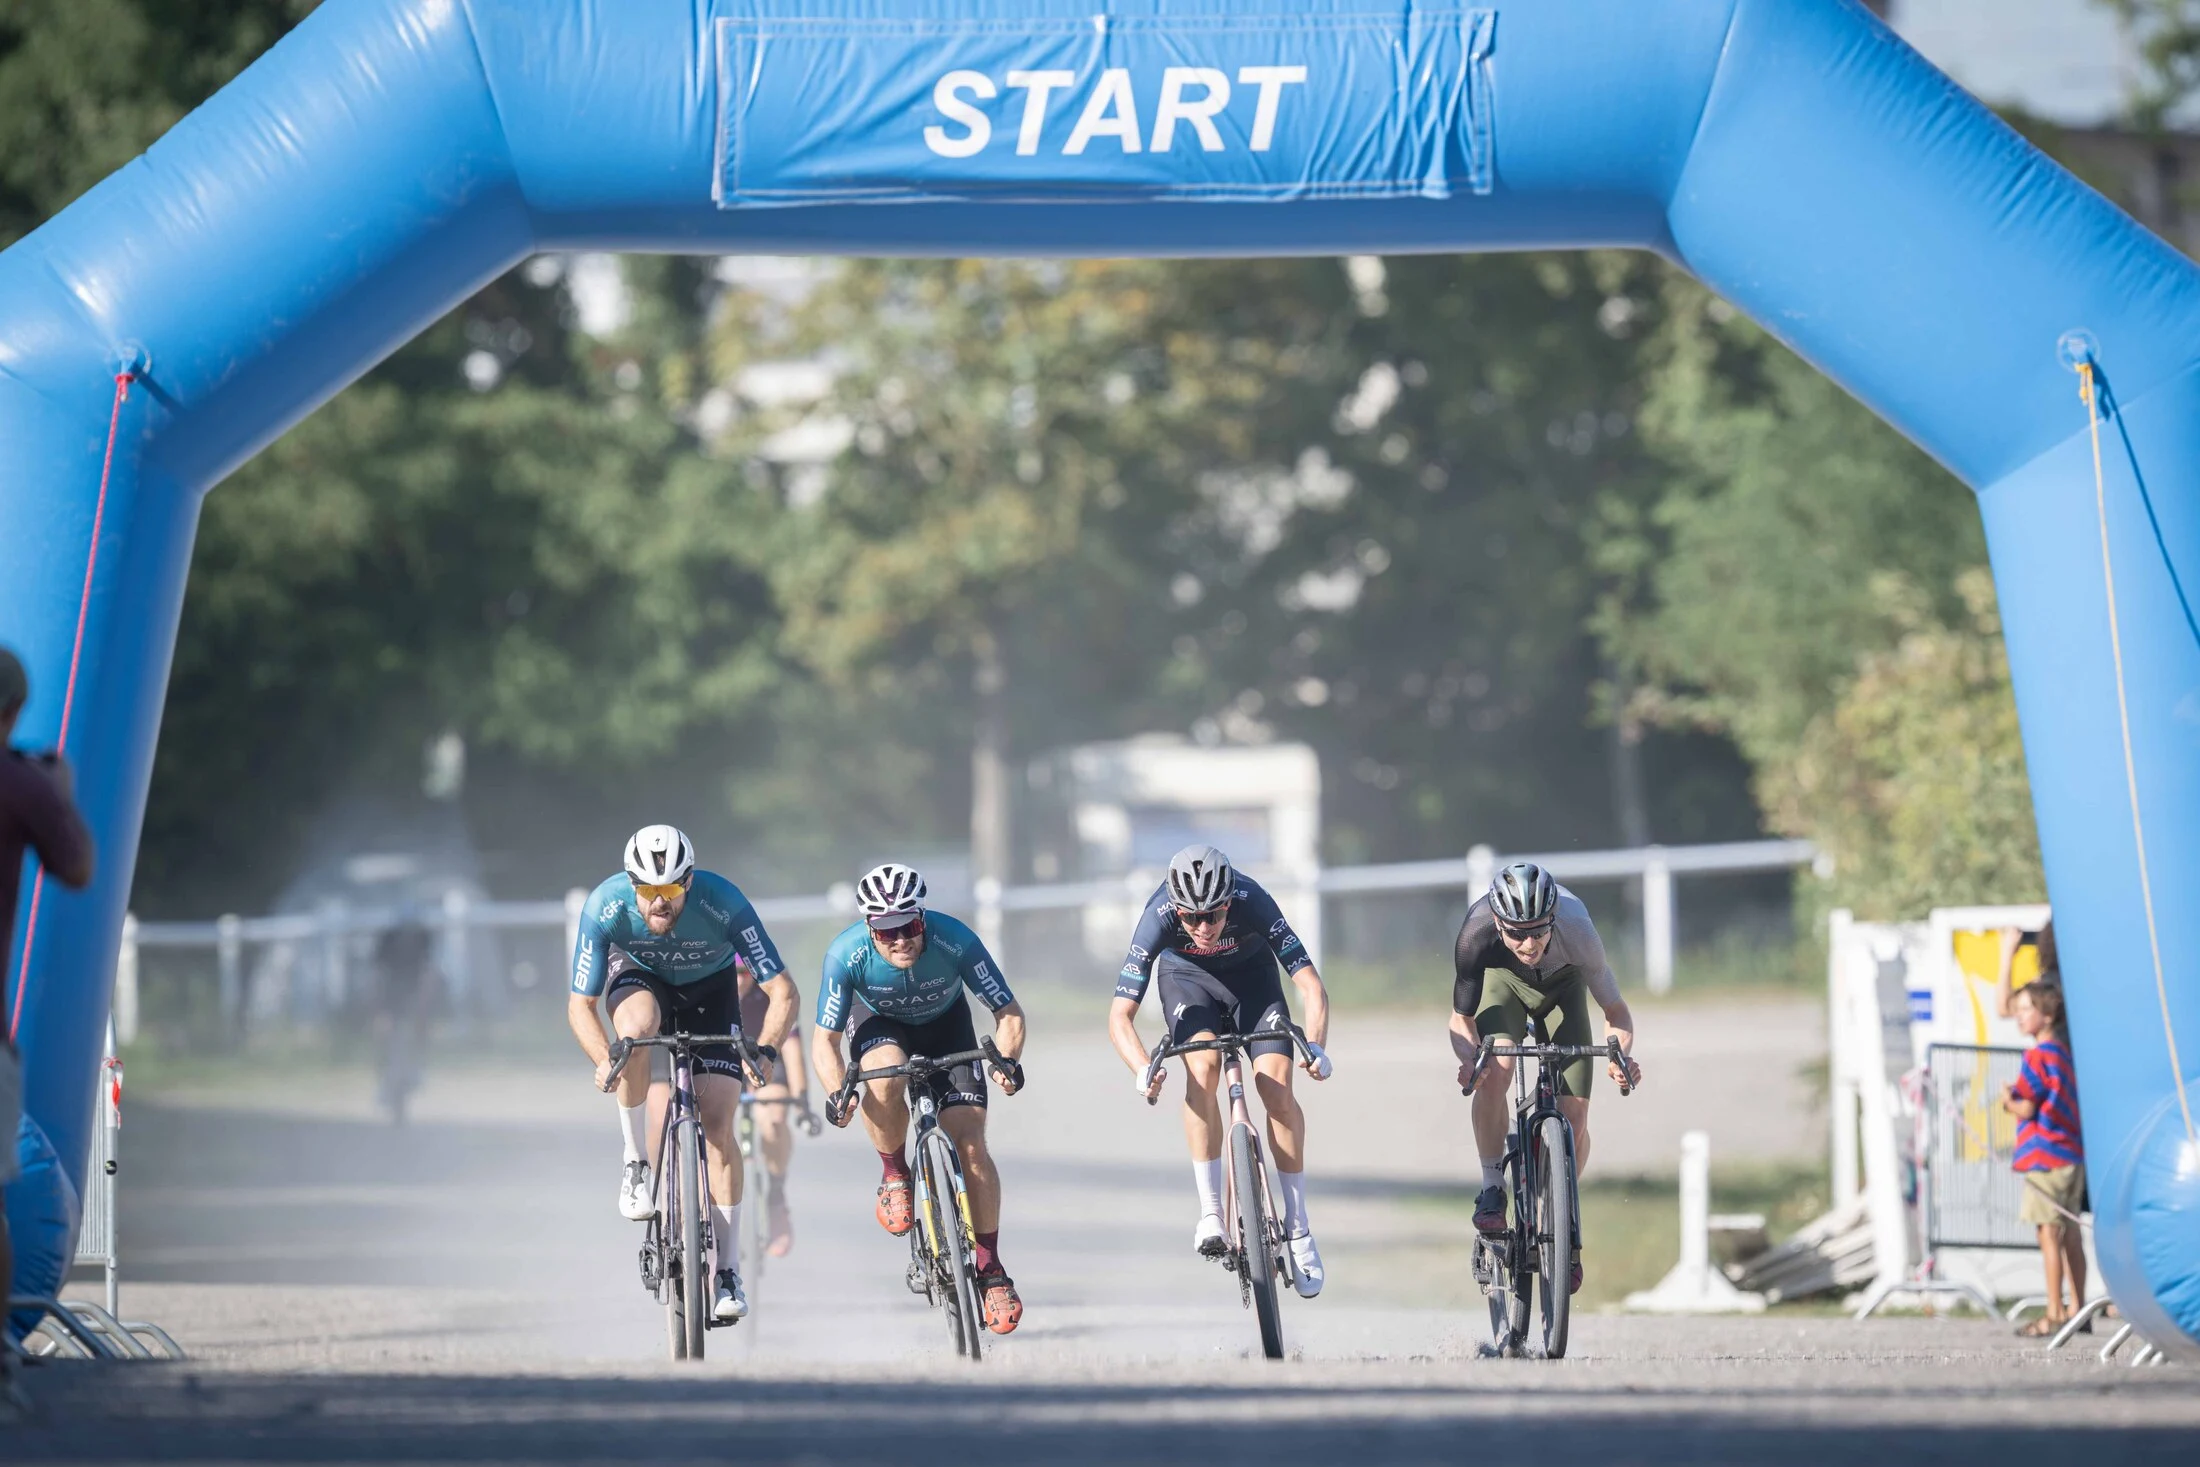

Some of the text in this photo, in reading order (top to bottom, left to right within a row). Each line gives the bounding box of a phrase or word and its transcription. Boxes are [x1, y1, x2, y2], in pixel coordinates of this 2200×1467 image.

[923, 65, 1307, 158] START
[574, 933, 593, 992] BMC
[741, 925, 778, 975] BMC
[973, 960, 1010, 1006] BMC
[702, 1058, 740, 1073] BMC
[947, 1092, 984, 1103] BMC
